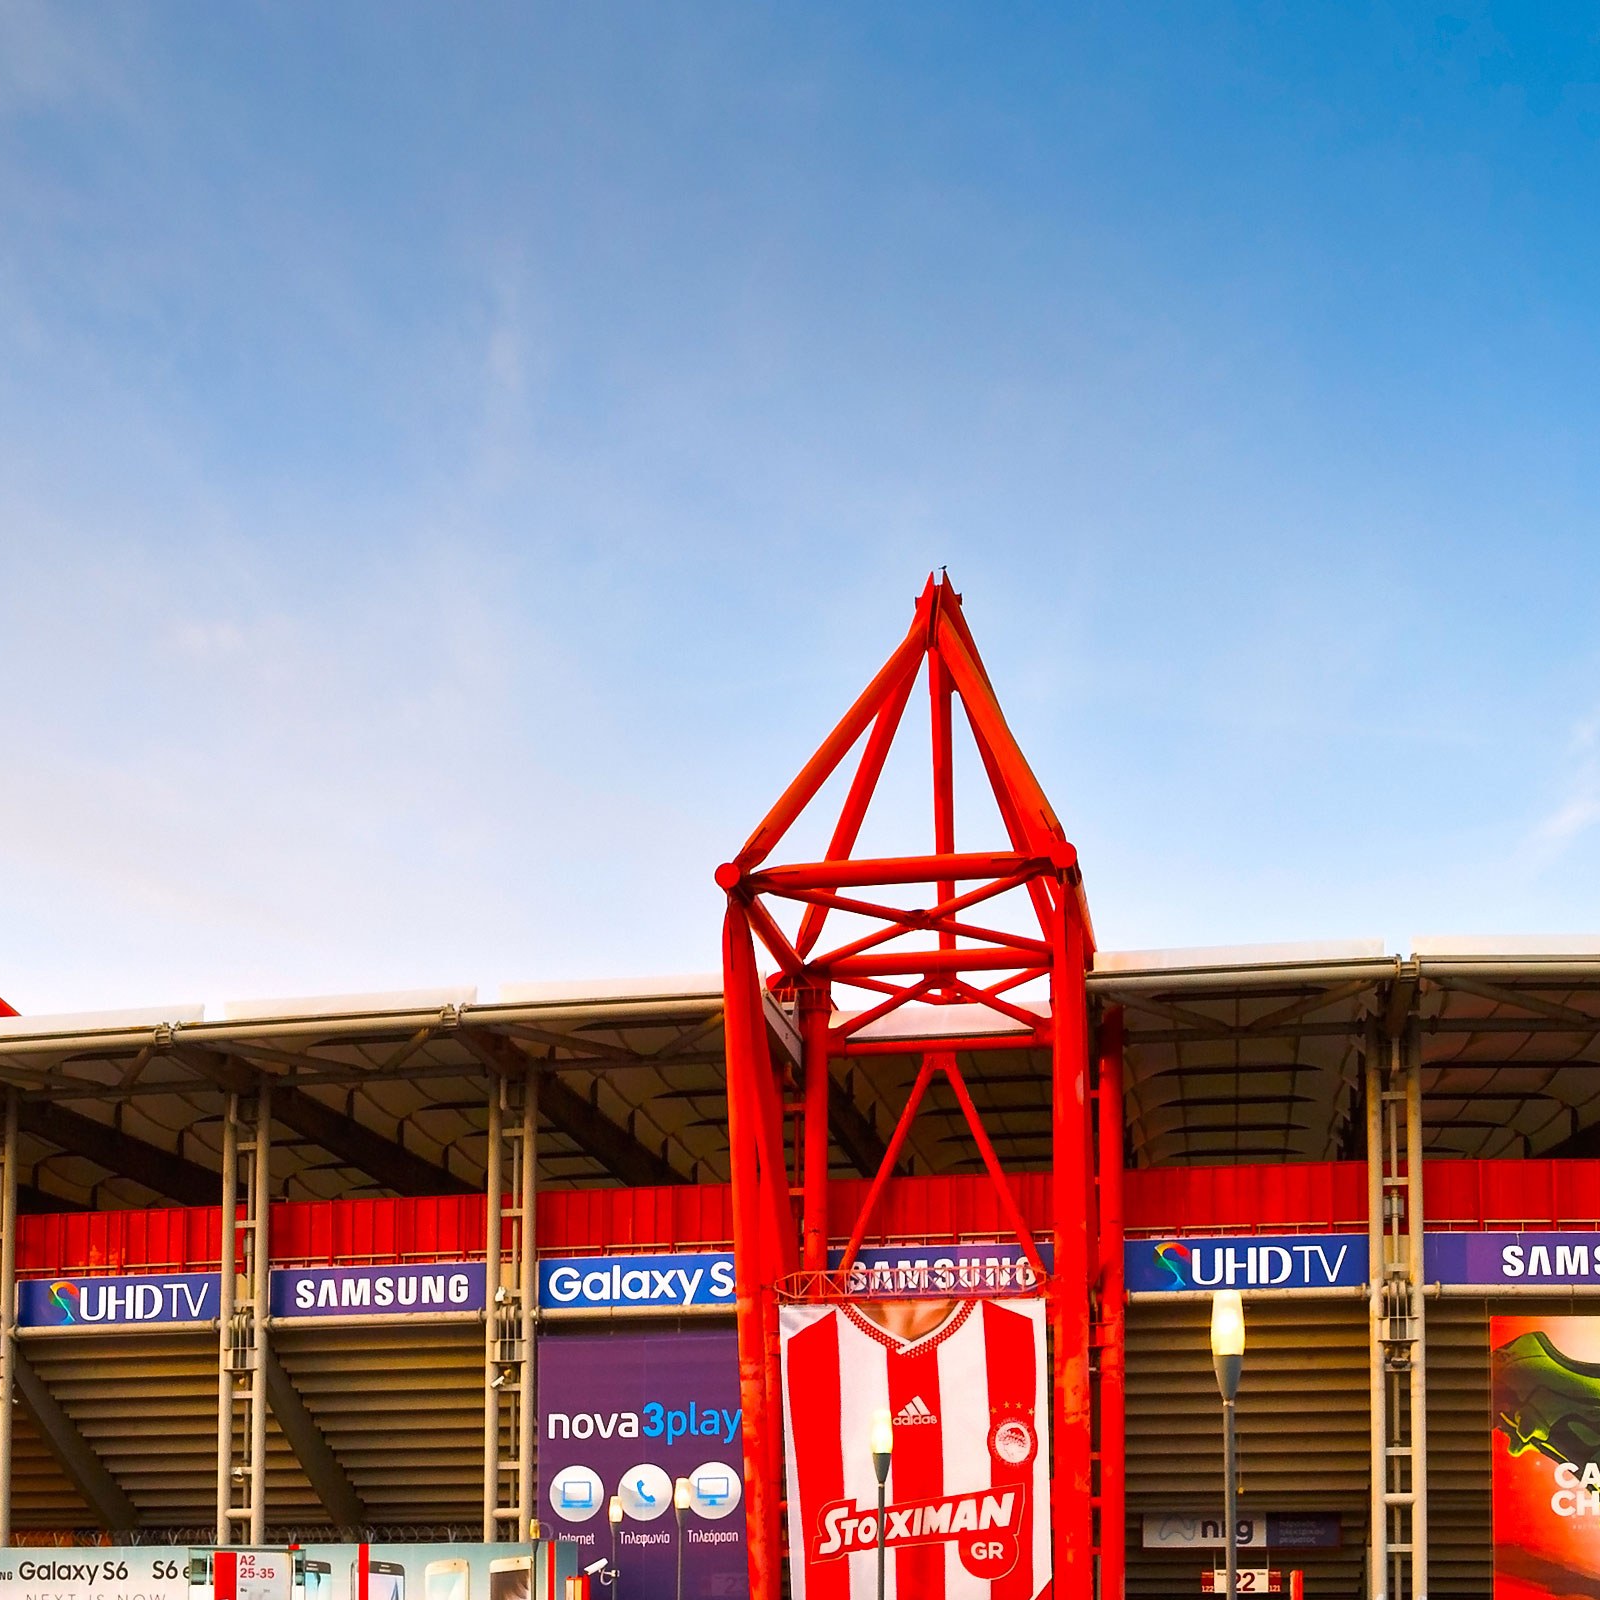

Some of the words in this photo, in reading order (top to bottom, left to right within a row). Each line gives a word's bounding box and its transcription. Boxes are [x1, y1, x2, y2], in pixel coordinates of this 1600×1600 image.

[548, 1265, 704, 1305] Galaxy
[709, 1261, 735, 1297] S
[849, 1256, 1037, 1292] SAMSUNG
[296, 1273, 469, 1310] SAMSUNG
[892, 1413, 938, 1426] adidas
[819, 1492, 1016, 1554] STOXIMAN
[620, 1531, 670, 1547] Τηλεφωνία
[687, 1529, 739, 1546] Τηλεόραση
[240, 1555, 255, 1565] A2
[971, 1542, 1004, 1560] GR
[19, 1561, 98, 1585] Galaxy
[103, 1561, 128, 1580] S6
[152, 1560, 178, 1580] S6
[240, 1568, 275, 1579] 25-35
